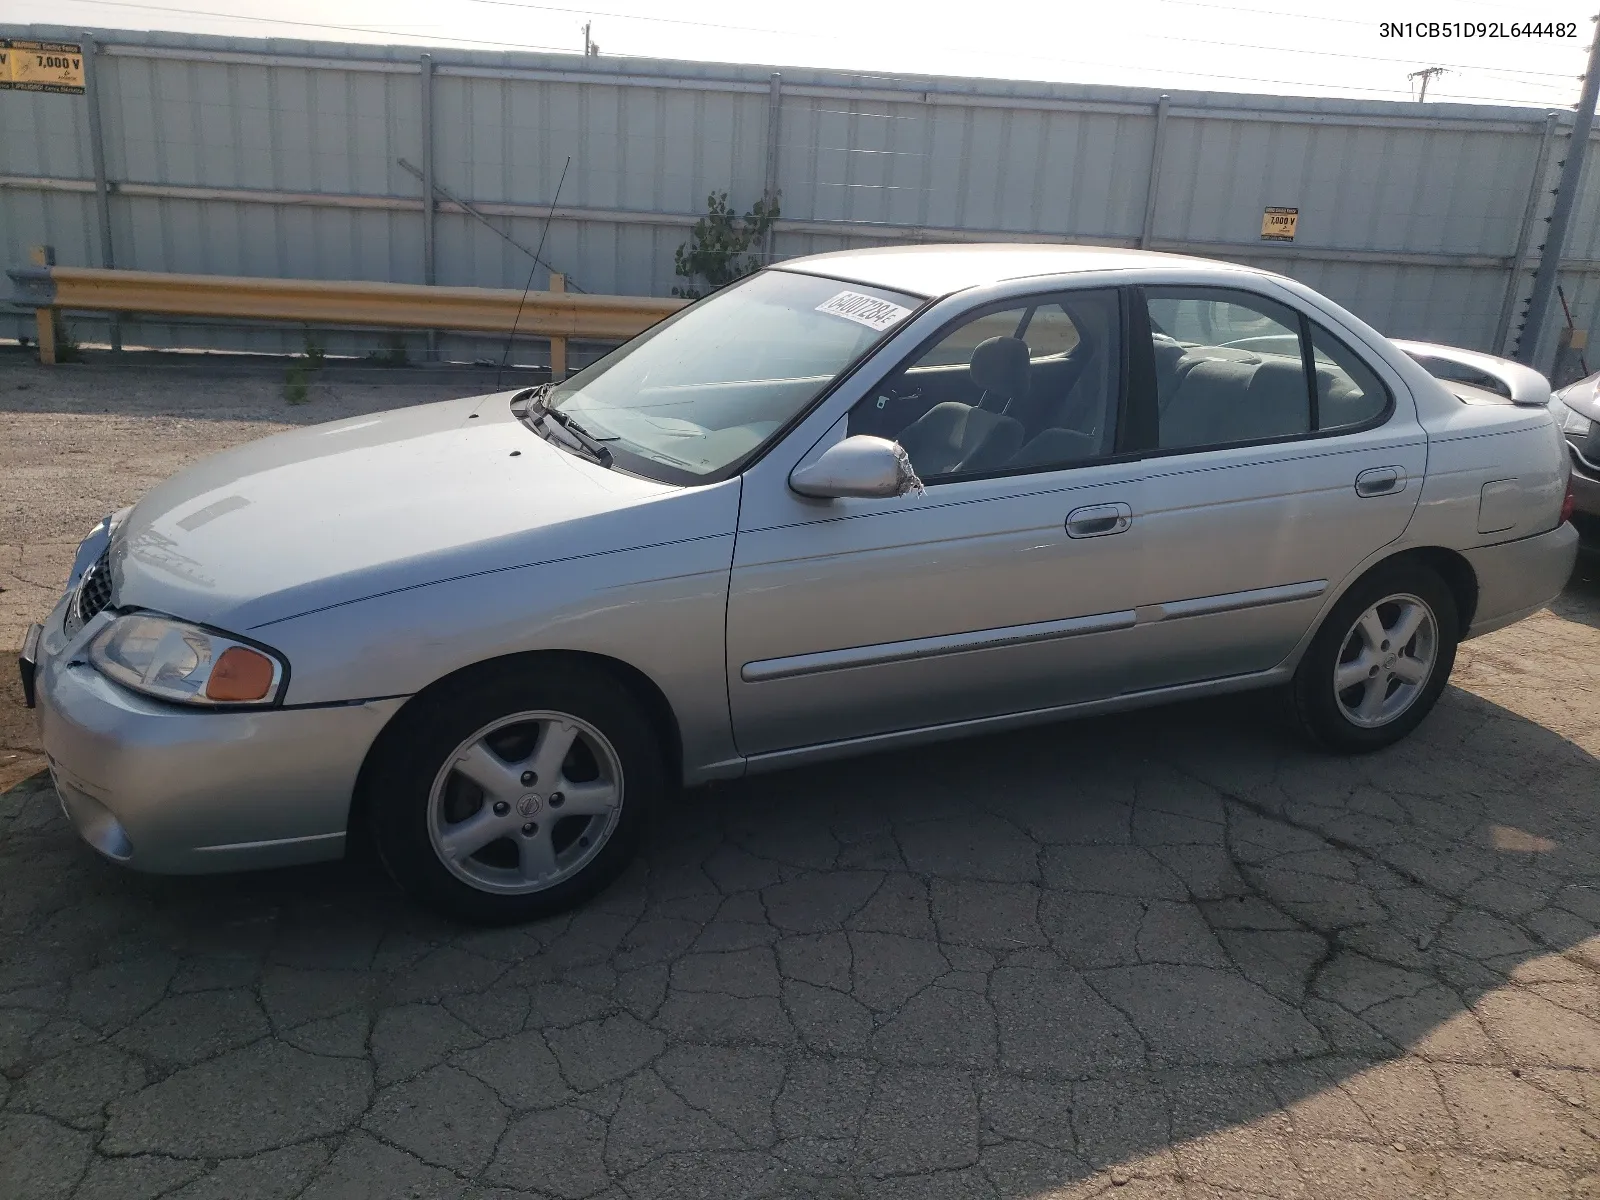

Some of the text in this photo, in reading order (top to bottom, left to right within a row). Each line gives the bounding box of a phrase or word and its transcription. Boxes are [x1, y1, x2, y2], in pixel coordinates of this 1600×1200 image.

[36, 55, 80, 70] 7,000 V
[1270, 216, 1296, 225] 7,000 V
